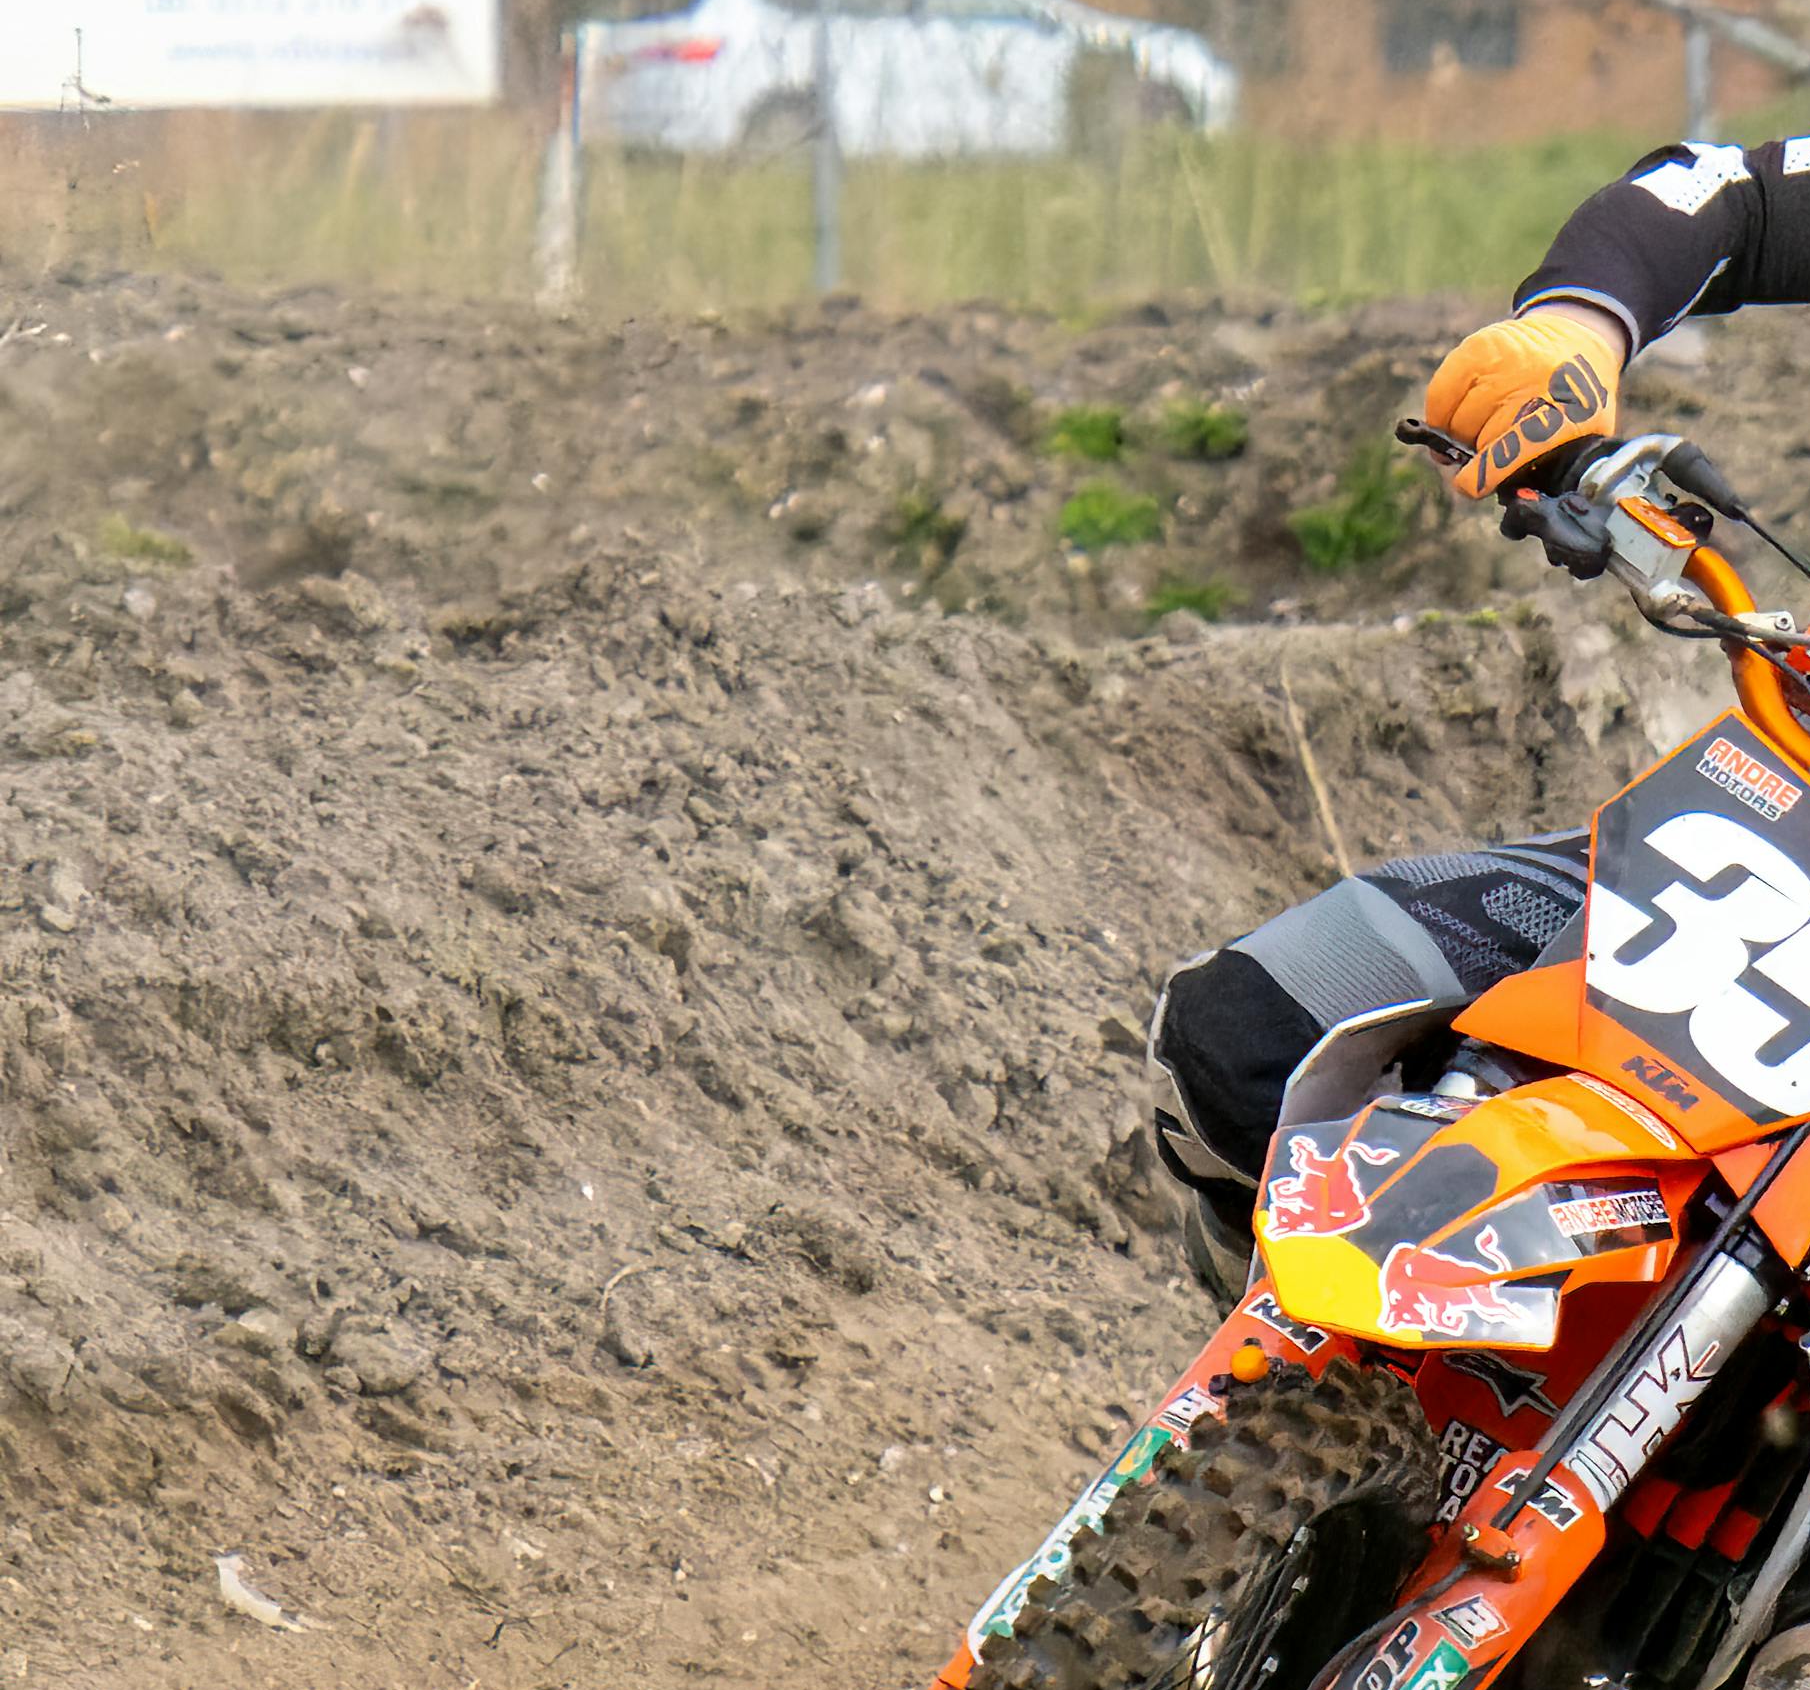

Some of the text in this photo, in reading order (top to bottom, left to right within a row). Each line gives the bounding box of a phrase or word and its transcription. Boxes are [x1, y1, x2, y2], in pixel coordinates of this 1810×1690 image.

[1698, 758, 1783, 820] MOTORS
[1704, 739, 1800, 809] ANDRE
[1621, 1056, 1699, 1111] KTM
